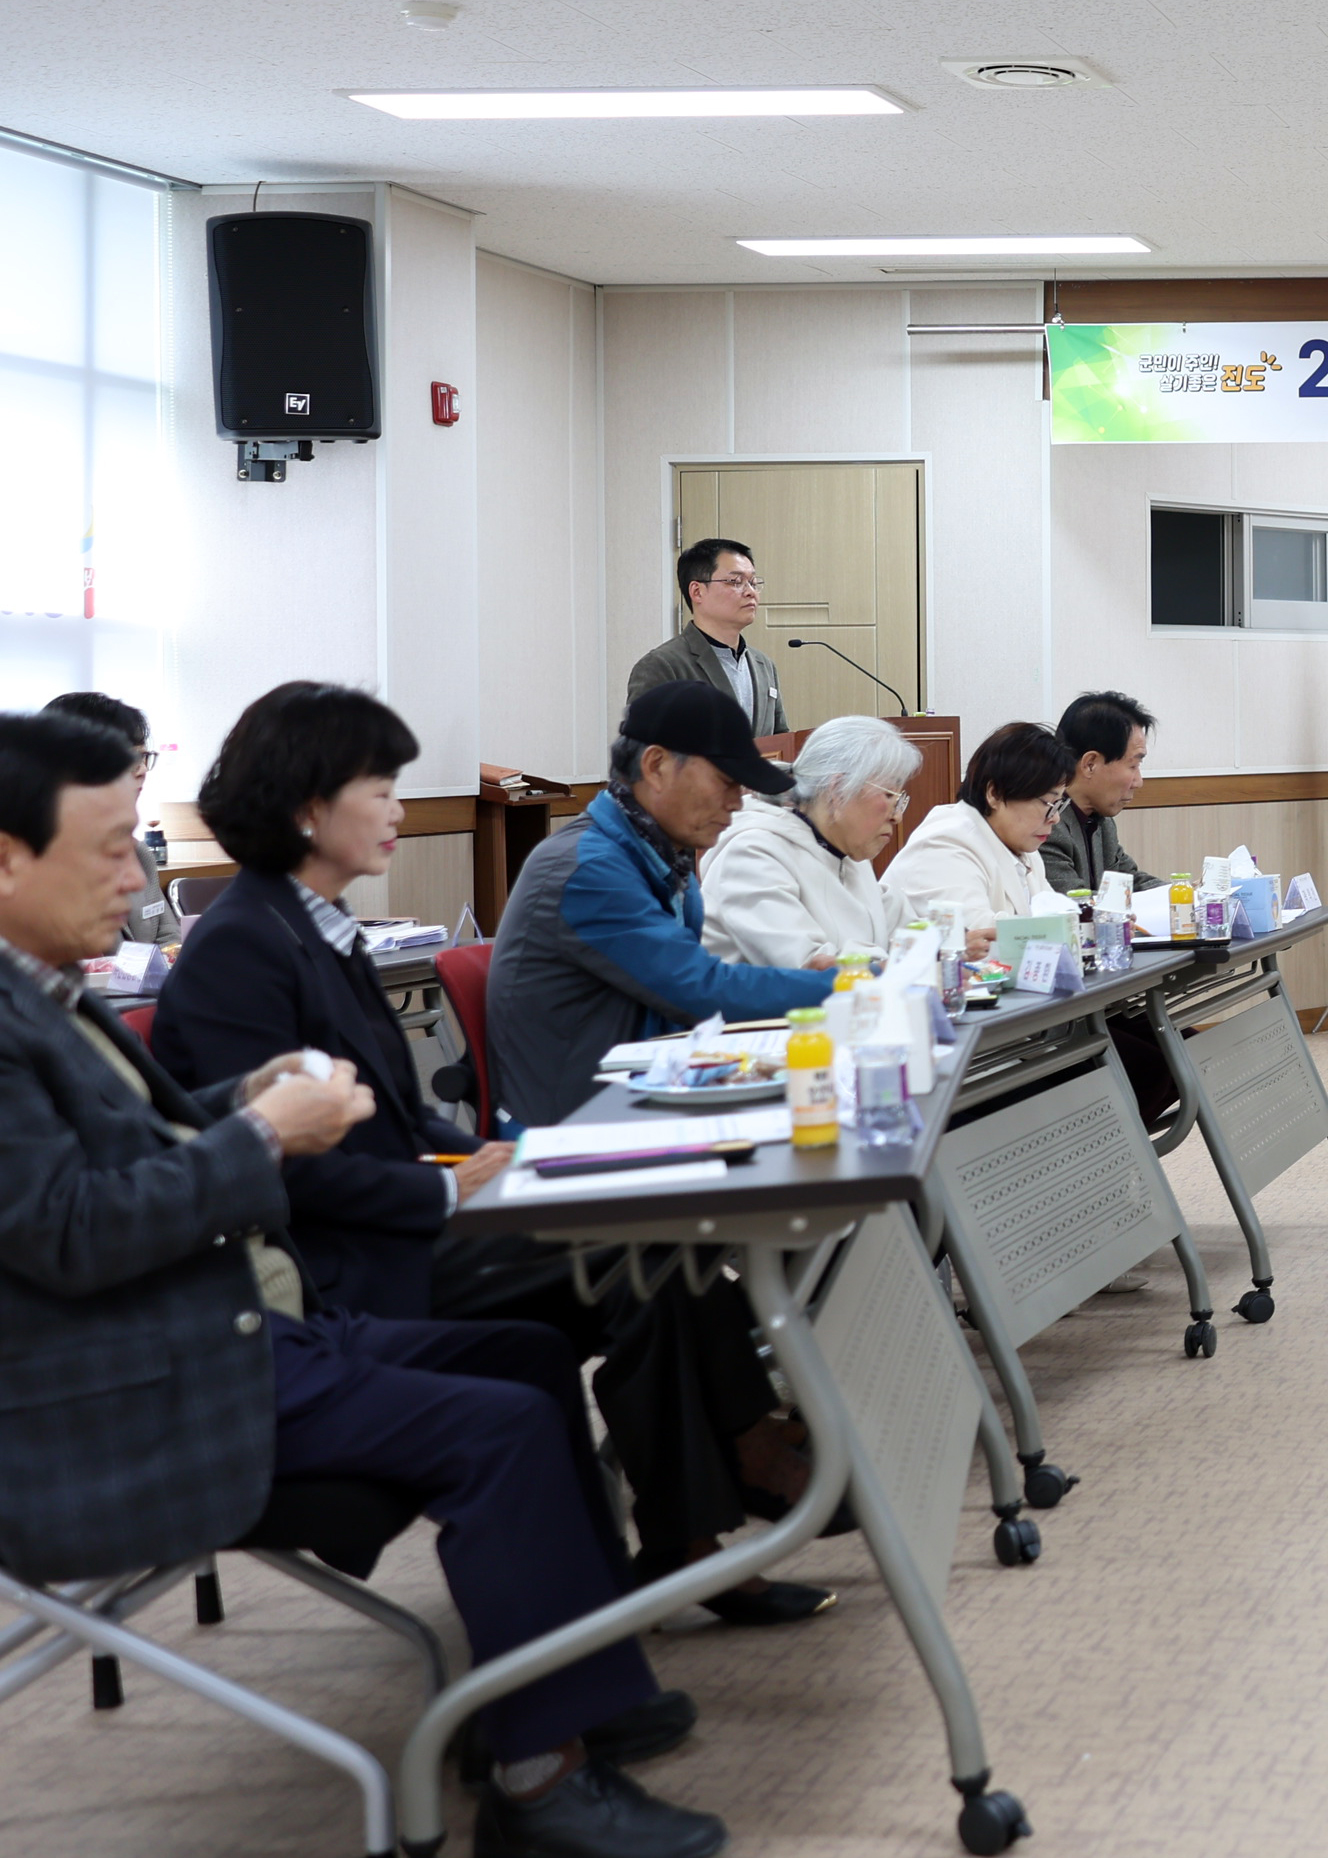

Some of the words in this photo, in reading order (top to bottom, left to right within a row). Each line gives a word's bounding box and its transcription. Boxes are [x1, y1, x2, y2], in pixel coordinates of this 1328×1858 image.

[1138, 353, 1182, 373] 군민이
[1184, 353, 1220, 372] 주인!
[1159, 373, 1218, 393] 살기좋은
[1219, 364, 1267, 392] 진도
